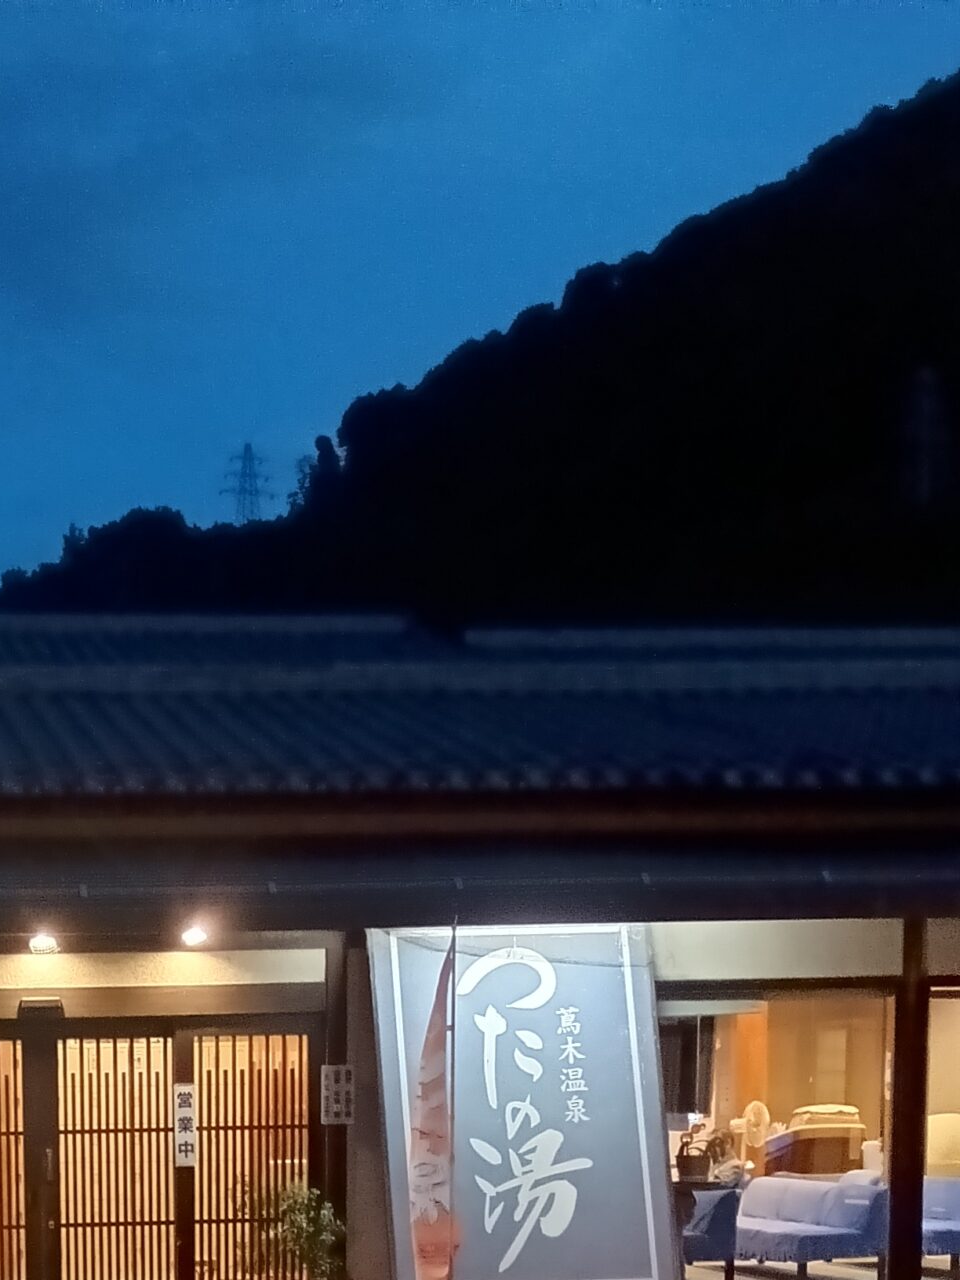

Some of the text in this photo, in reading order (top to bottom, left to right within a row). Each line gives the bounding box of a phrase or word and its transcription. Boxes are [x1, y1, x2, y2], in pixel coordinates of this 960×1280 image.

[455, 946, 593, 1273] つたの湯
[555, 1005, 591, 1124] 蔦木温泉
[176, 1090, 195, 1159] 営業中
